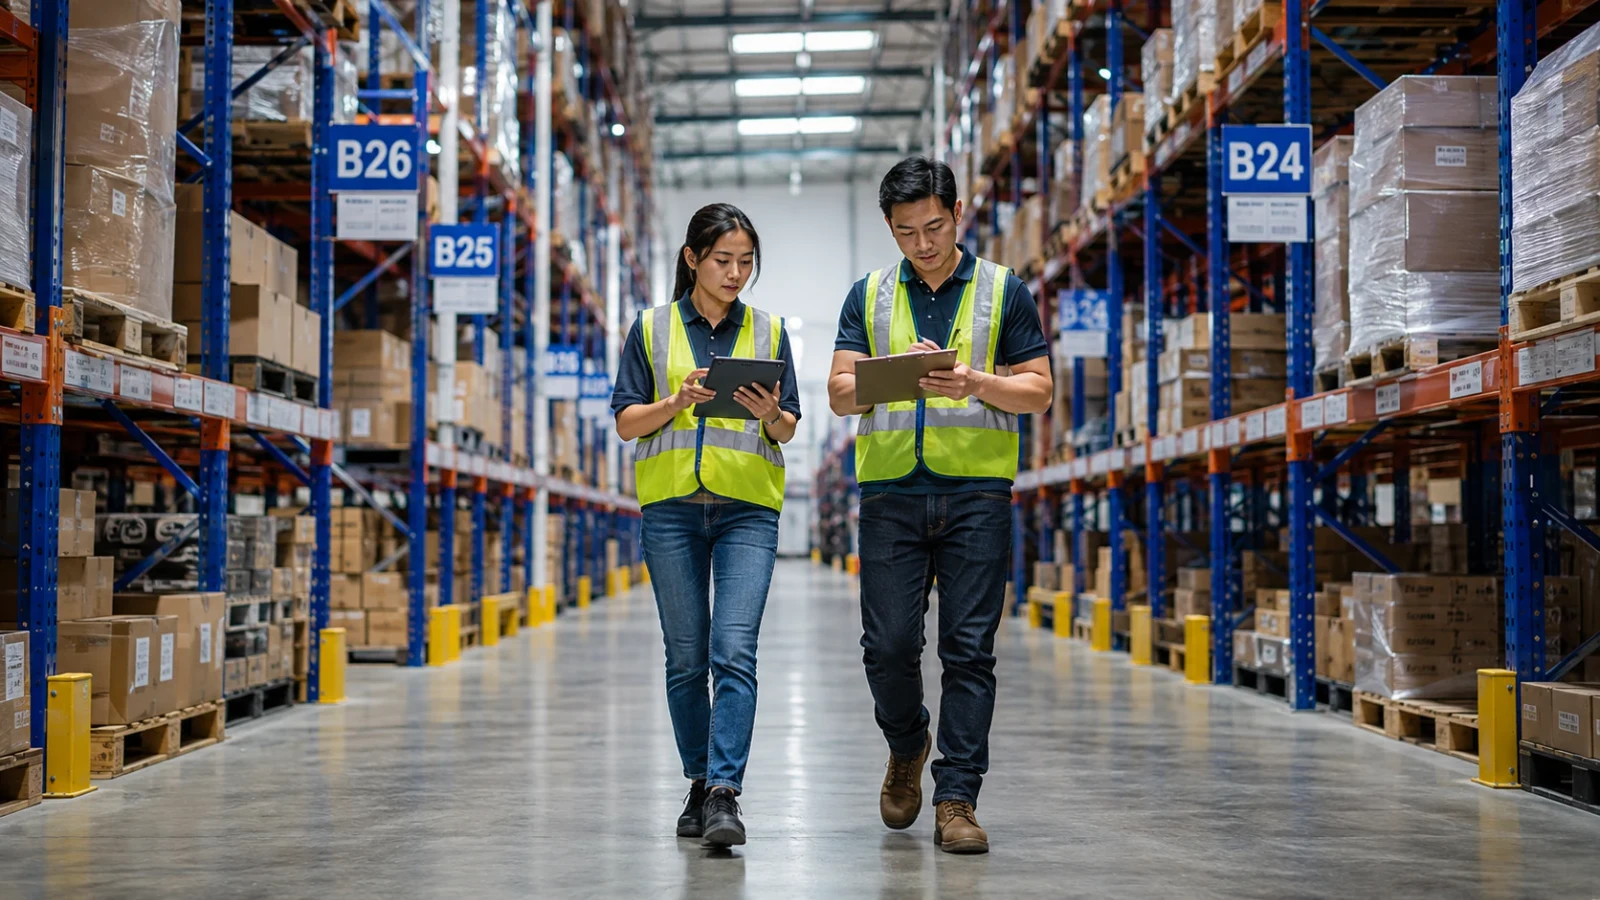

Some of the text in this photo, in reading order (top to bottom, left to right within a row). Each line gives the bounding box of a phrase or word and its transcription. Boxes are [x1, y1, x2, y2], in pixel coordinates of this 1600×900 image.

[337, 139, 412, 179] B26
[1229, 141, 1304, 180] B24
[434, 235, 494, 268] B25
